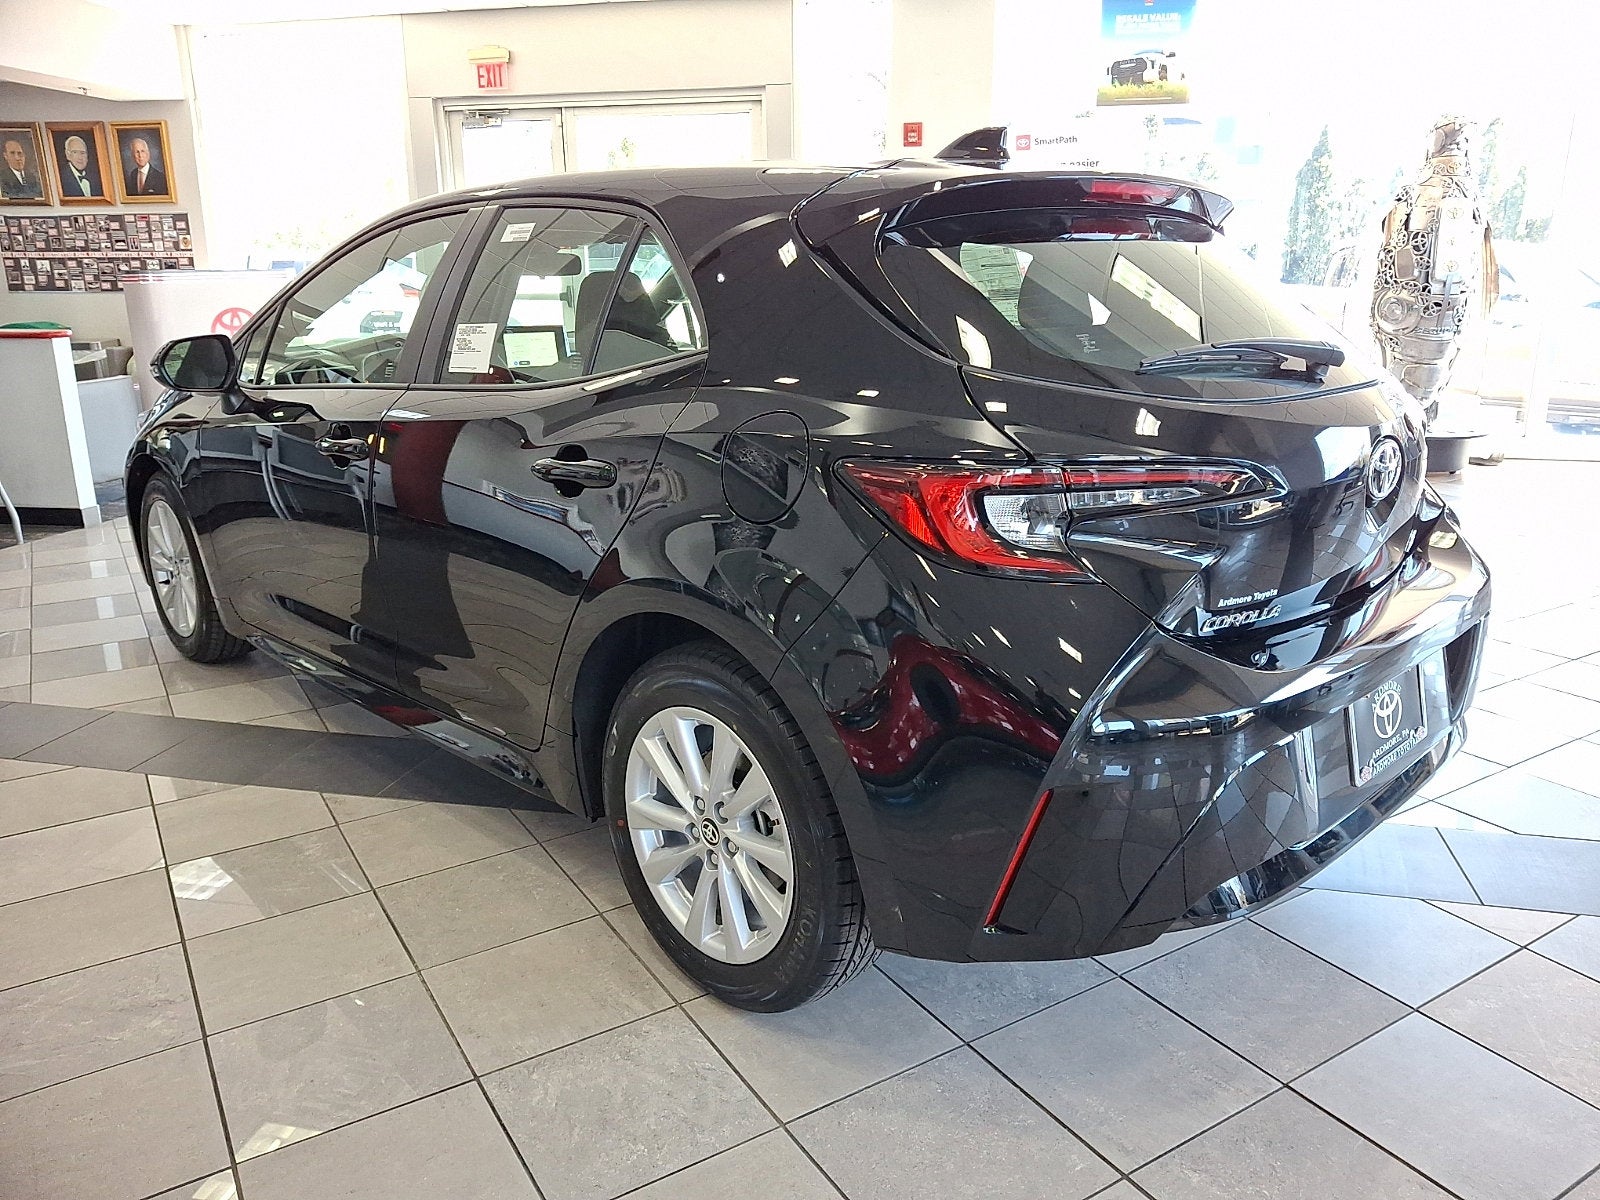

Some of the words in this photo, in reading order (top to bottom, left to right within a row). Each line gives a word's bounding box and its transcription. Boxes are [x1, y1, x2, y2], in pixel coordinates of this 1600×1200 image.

[476, 63, 504, 89] EXIT
[1034, 135, 1078, 146] SmartPath
[1217, 594, 1253, 608] Ardmore
[1253, 588, 1279, 601] Toyota
[1202, 604, 1283, 633] COROLLA
[1371, 680, 1402, 713] ARDMORE
